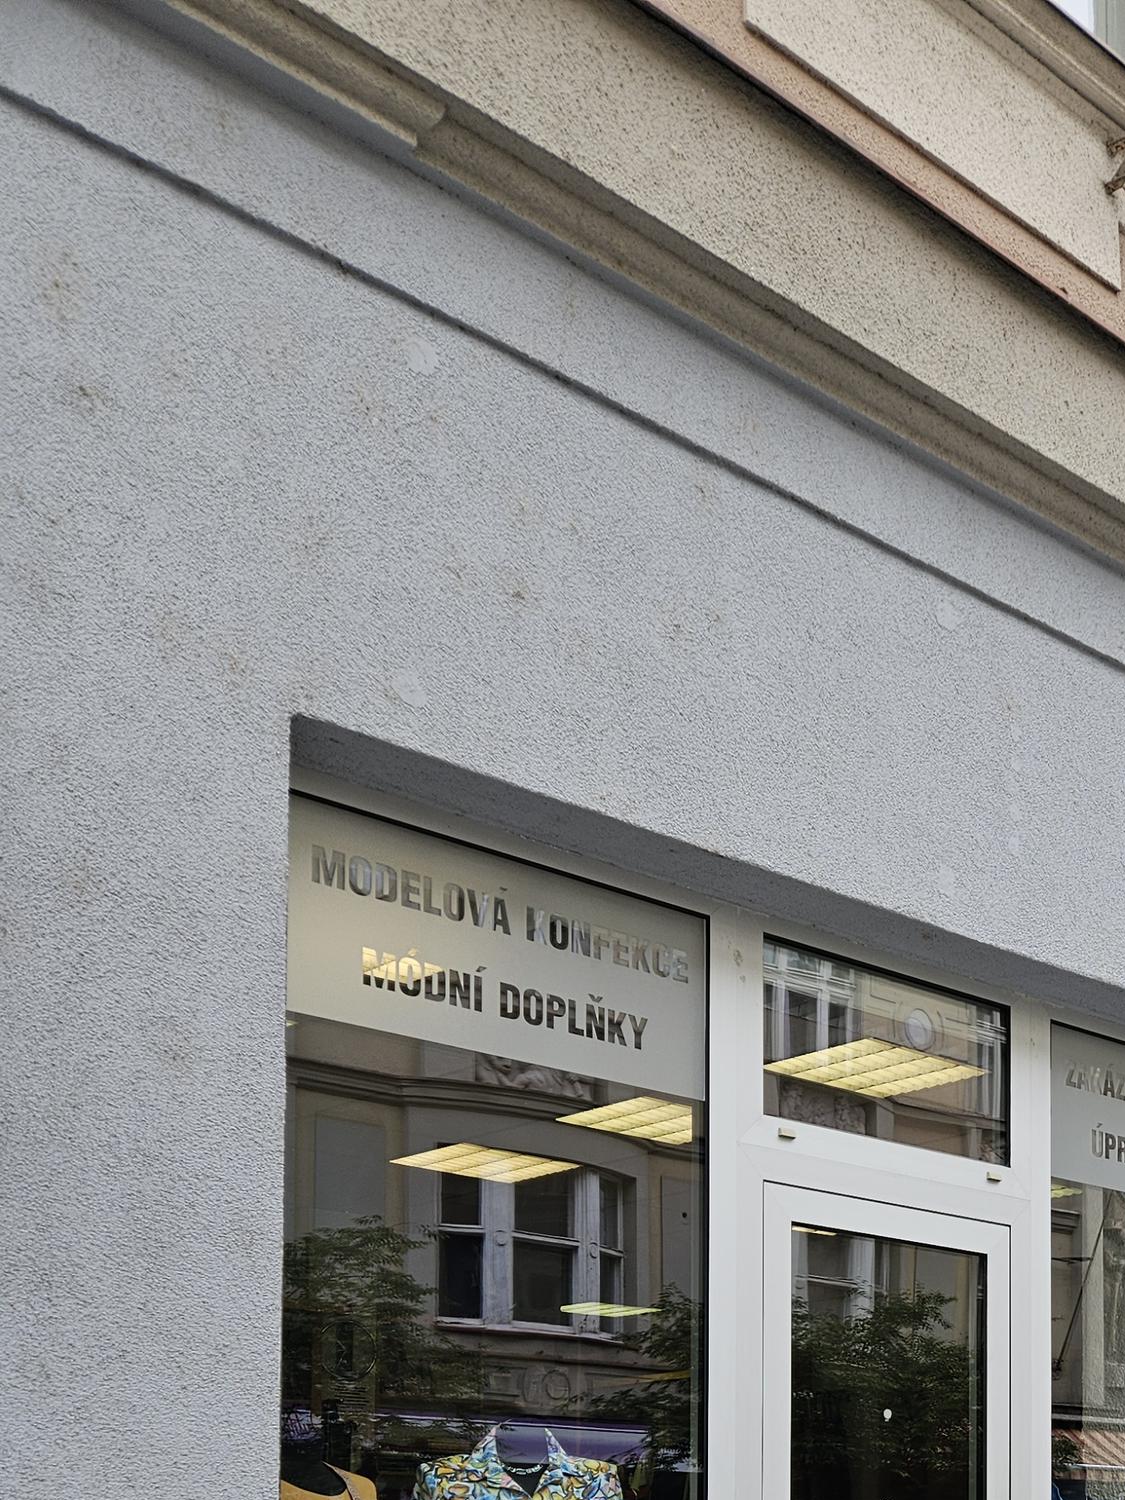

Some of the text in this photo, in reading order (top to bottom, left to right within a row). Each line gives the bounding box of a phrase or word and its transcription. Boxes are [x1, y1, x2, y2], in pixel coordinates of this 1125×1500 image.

[312, 844, 690, 984] MODELOVÁ KONFEKCE
[361, 945, 649, 1050] MÓDNÍ DOPLŇKY
